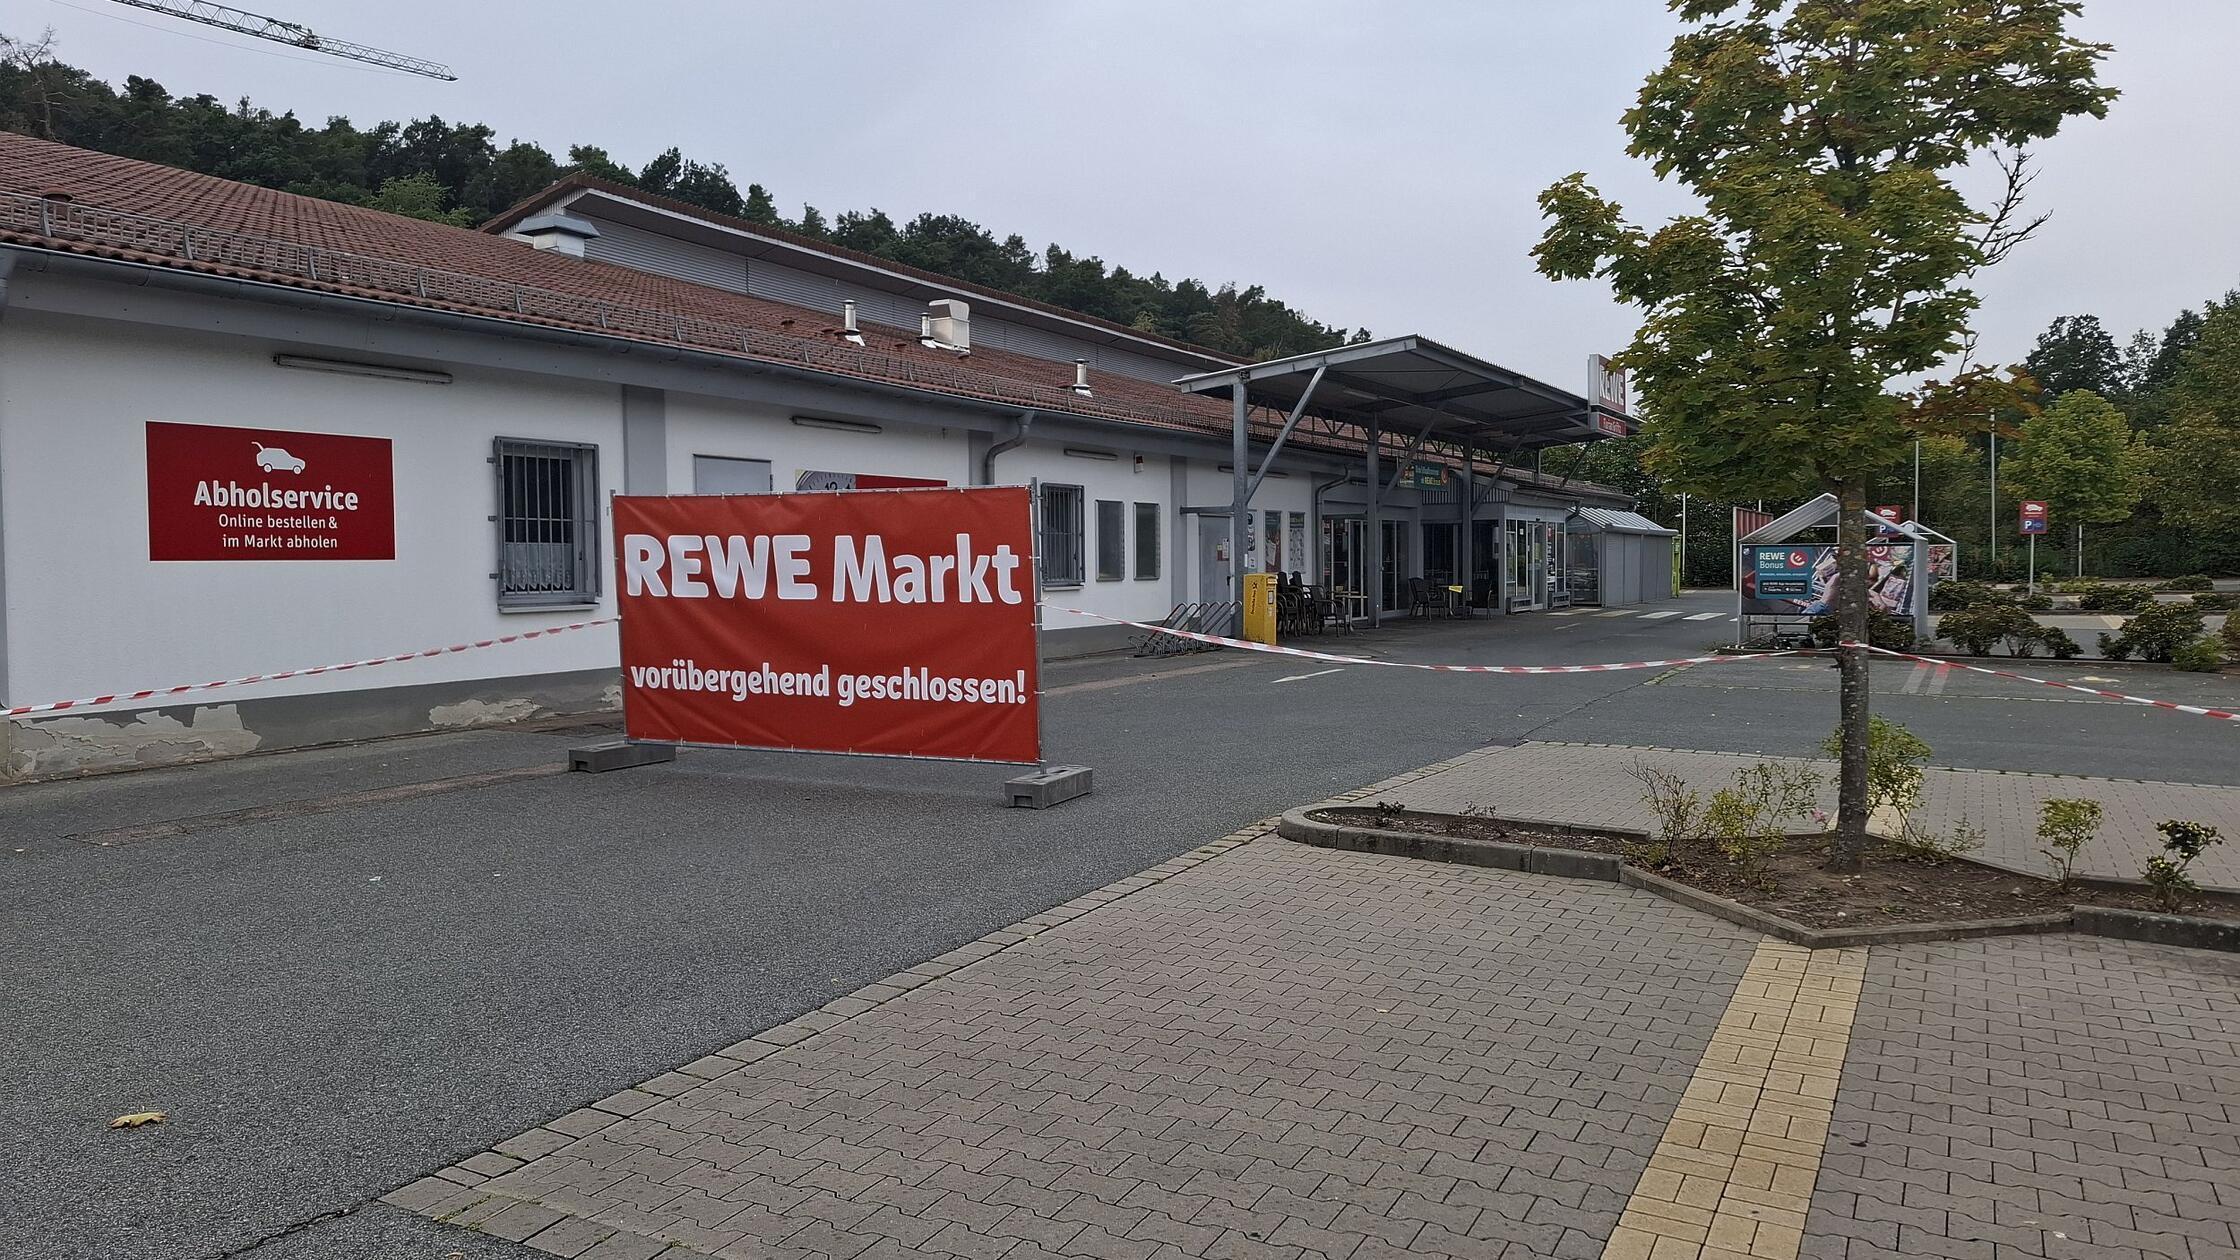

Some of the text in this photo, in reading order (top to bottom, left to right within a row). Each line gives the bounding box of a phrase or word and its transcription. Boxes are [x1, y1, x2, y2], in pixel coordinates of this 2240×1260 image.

[193, 480, 359, 511] Abholservice
[218, 513, 338, 529] Online bestellen &
[2025, 520, 2033, 529] P
[223, 534, 338, 549] im Markt abholen
[1759, 551, 1785, 560] REWE
[623, 533, 1022, 604] REWE Markt
[1759, 560, 1784, 569] Bonus
[630, 659, 1026, 707] vorübergehend geschlossen!
